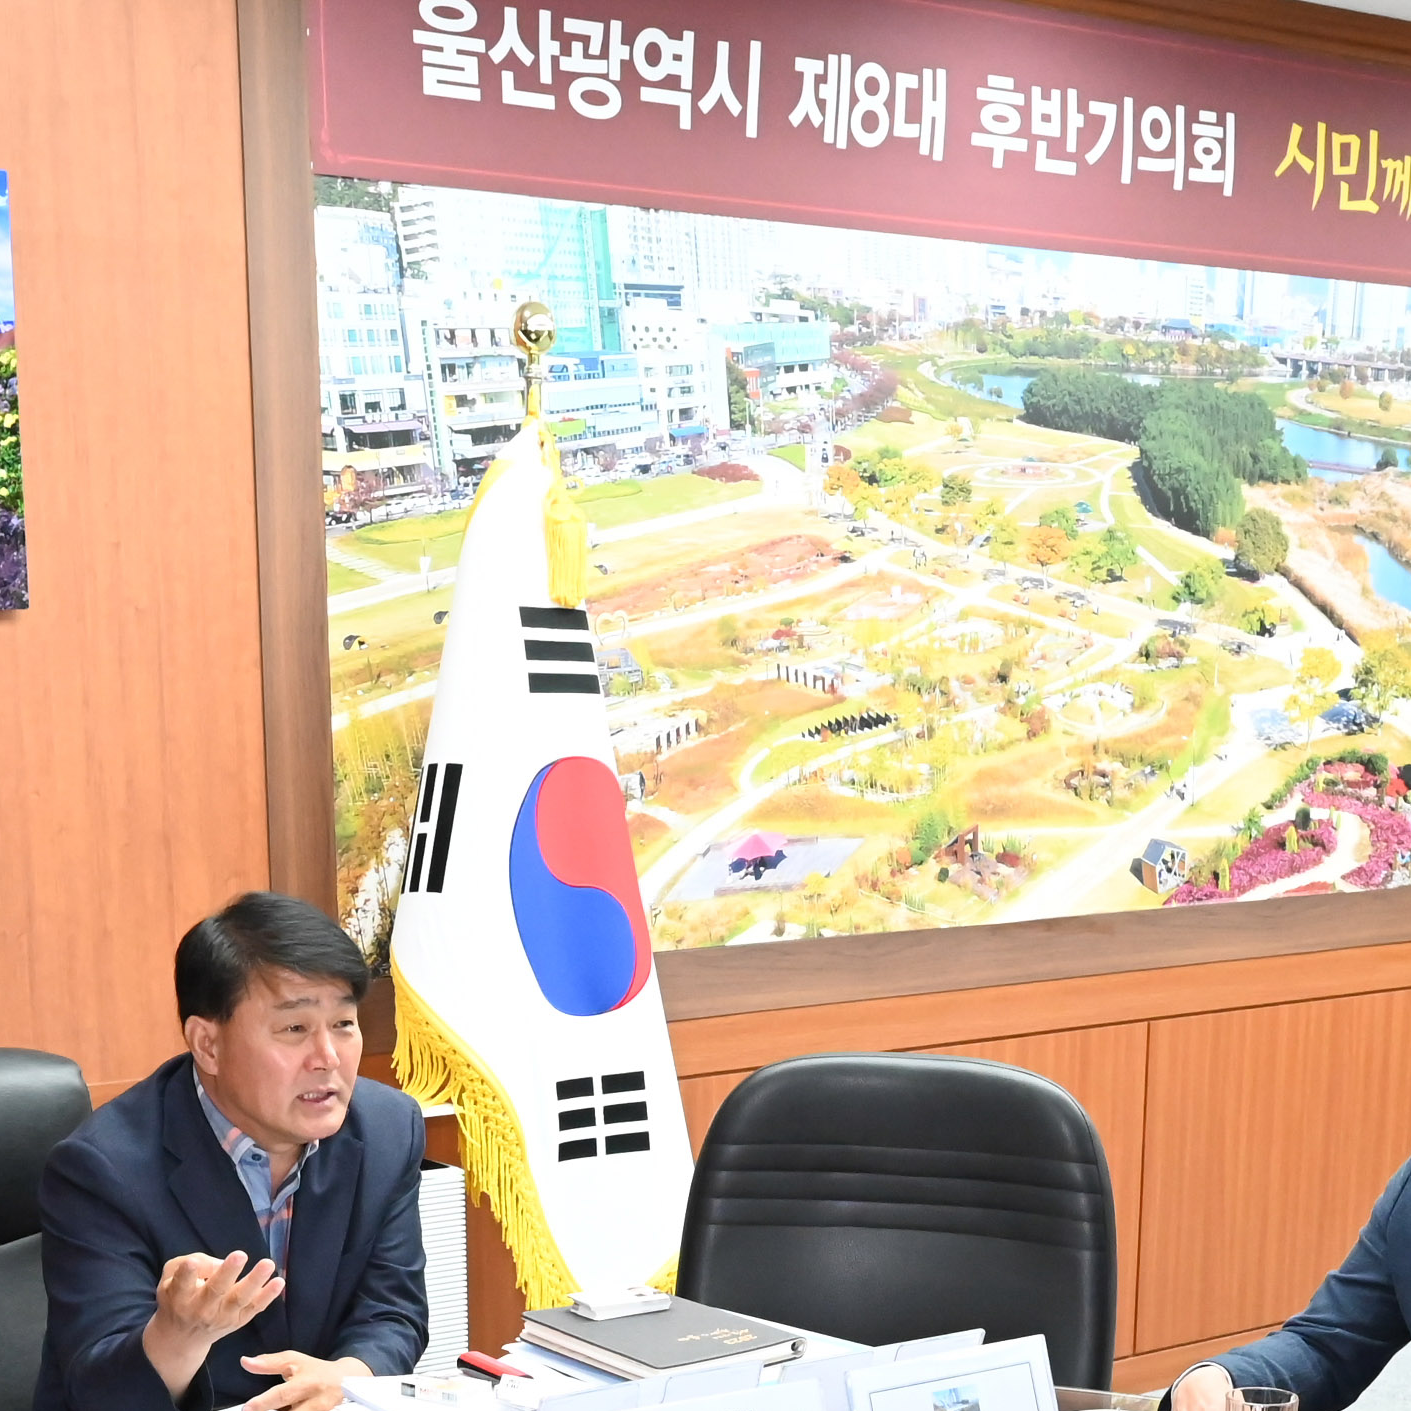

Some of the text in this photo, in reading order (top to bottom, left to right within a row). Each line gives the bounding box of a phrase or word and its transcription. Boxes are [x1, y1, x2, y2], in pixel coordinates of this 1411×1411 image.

[412, 0, 762, 138] 울산광역시
[787, 53, 947, 162] 제8대
[970, 74, 1236, 197] 후반기의회
